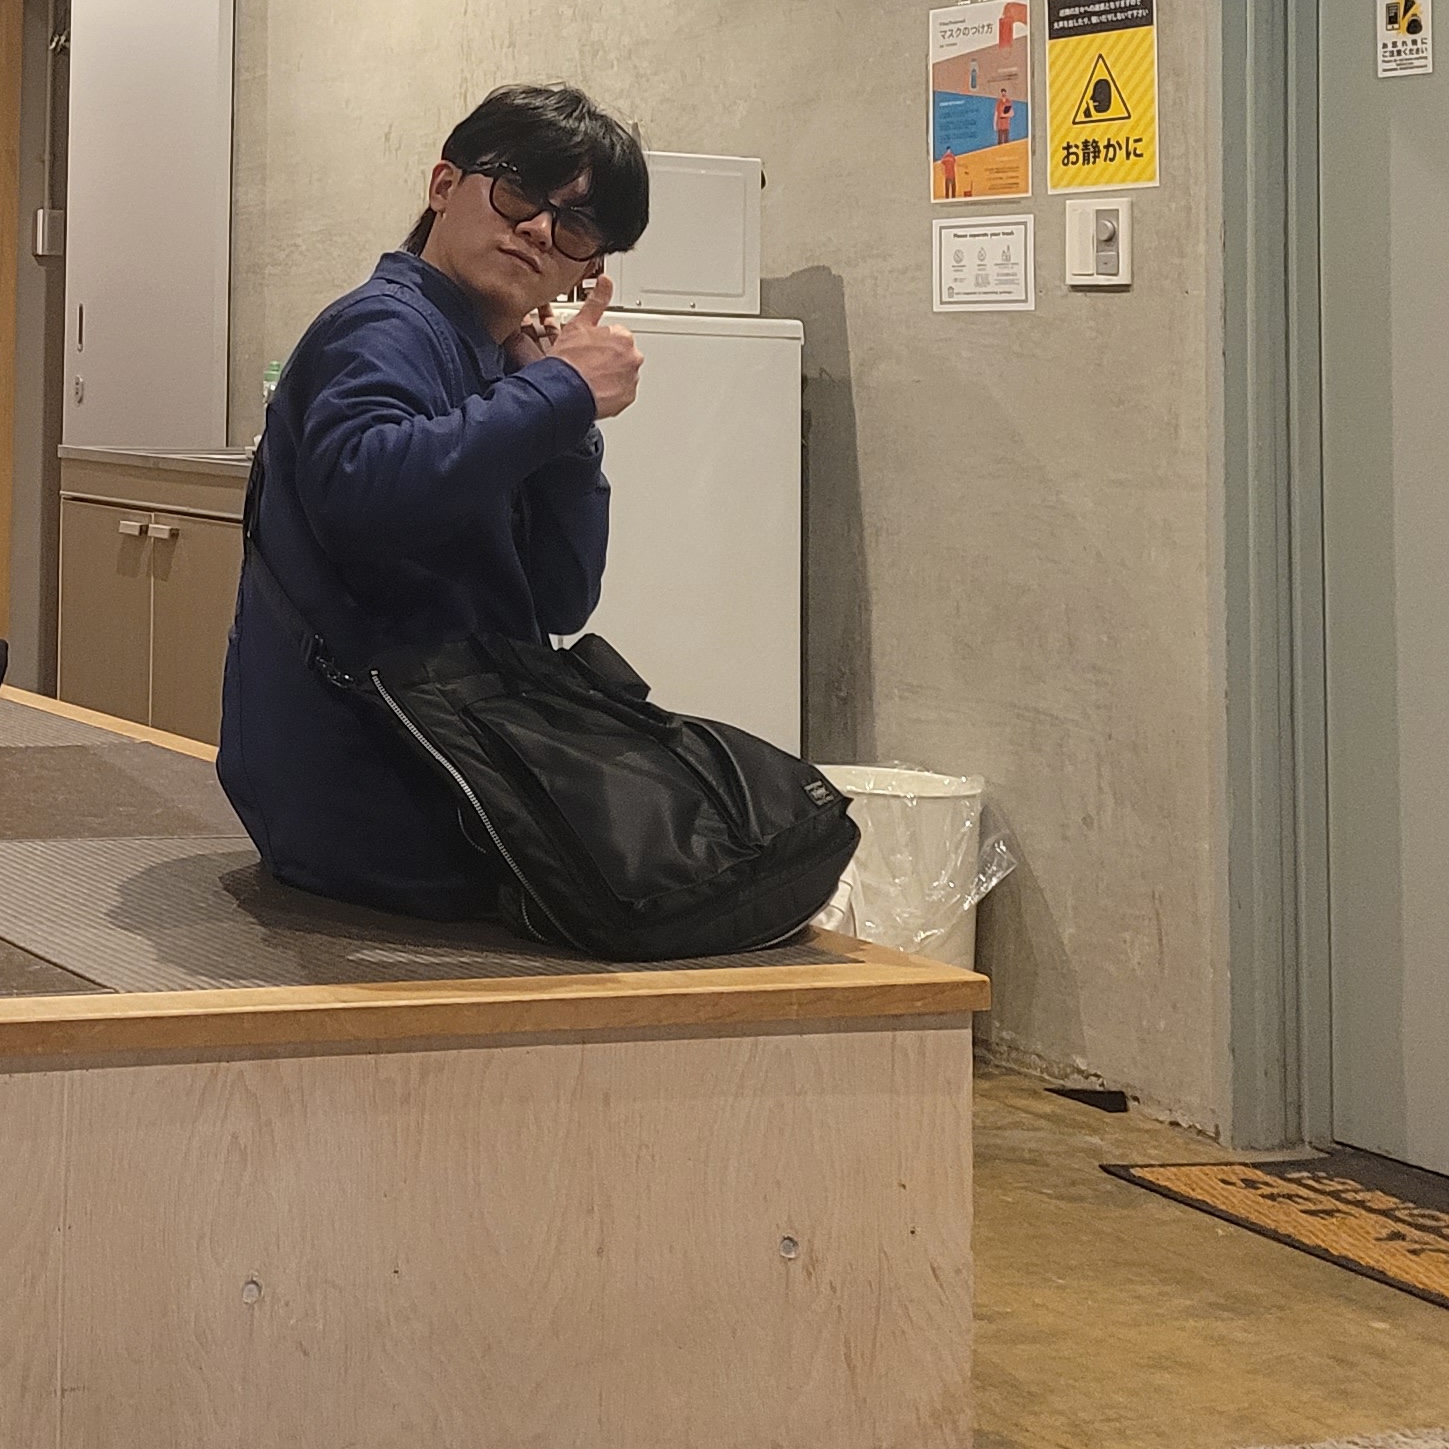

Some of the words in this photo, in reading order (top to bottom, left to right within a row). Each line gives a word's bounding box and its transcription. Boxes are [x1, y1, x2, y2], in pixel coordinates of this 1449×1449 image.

[939, 23, 994, 39] マスクのつけ方
[1061, 136, 1144, 167] お静かに
